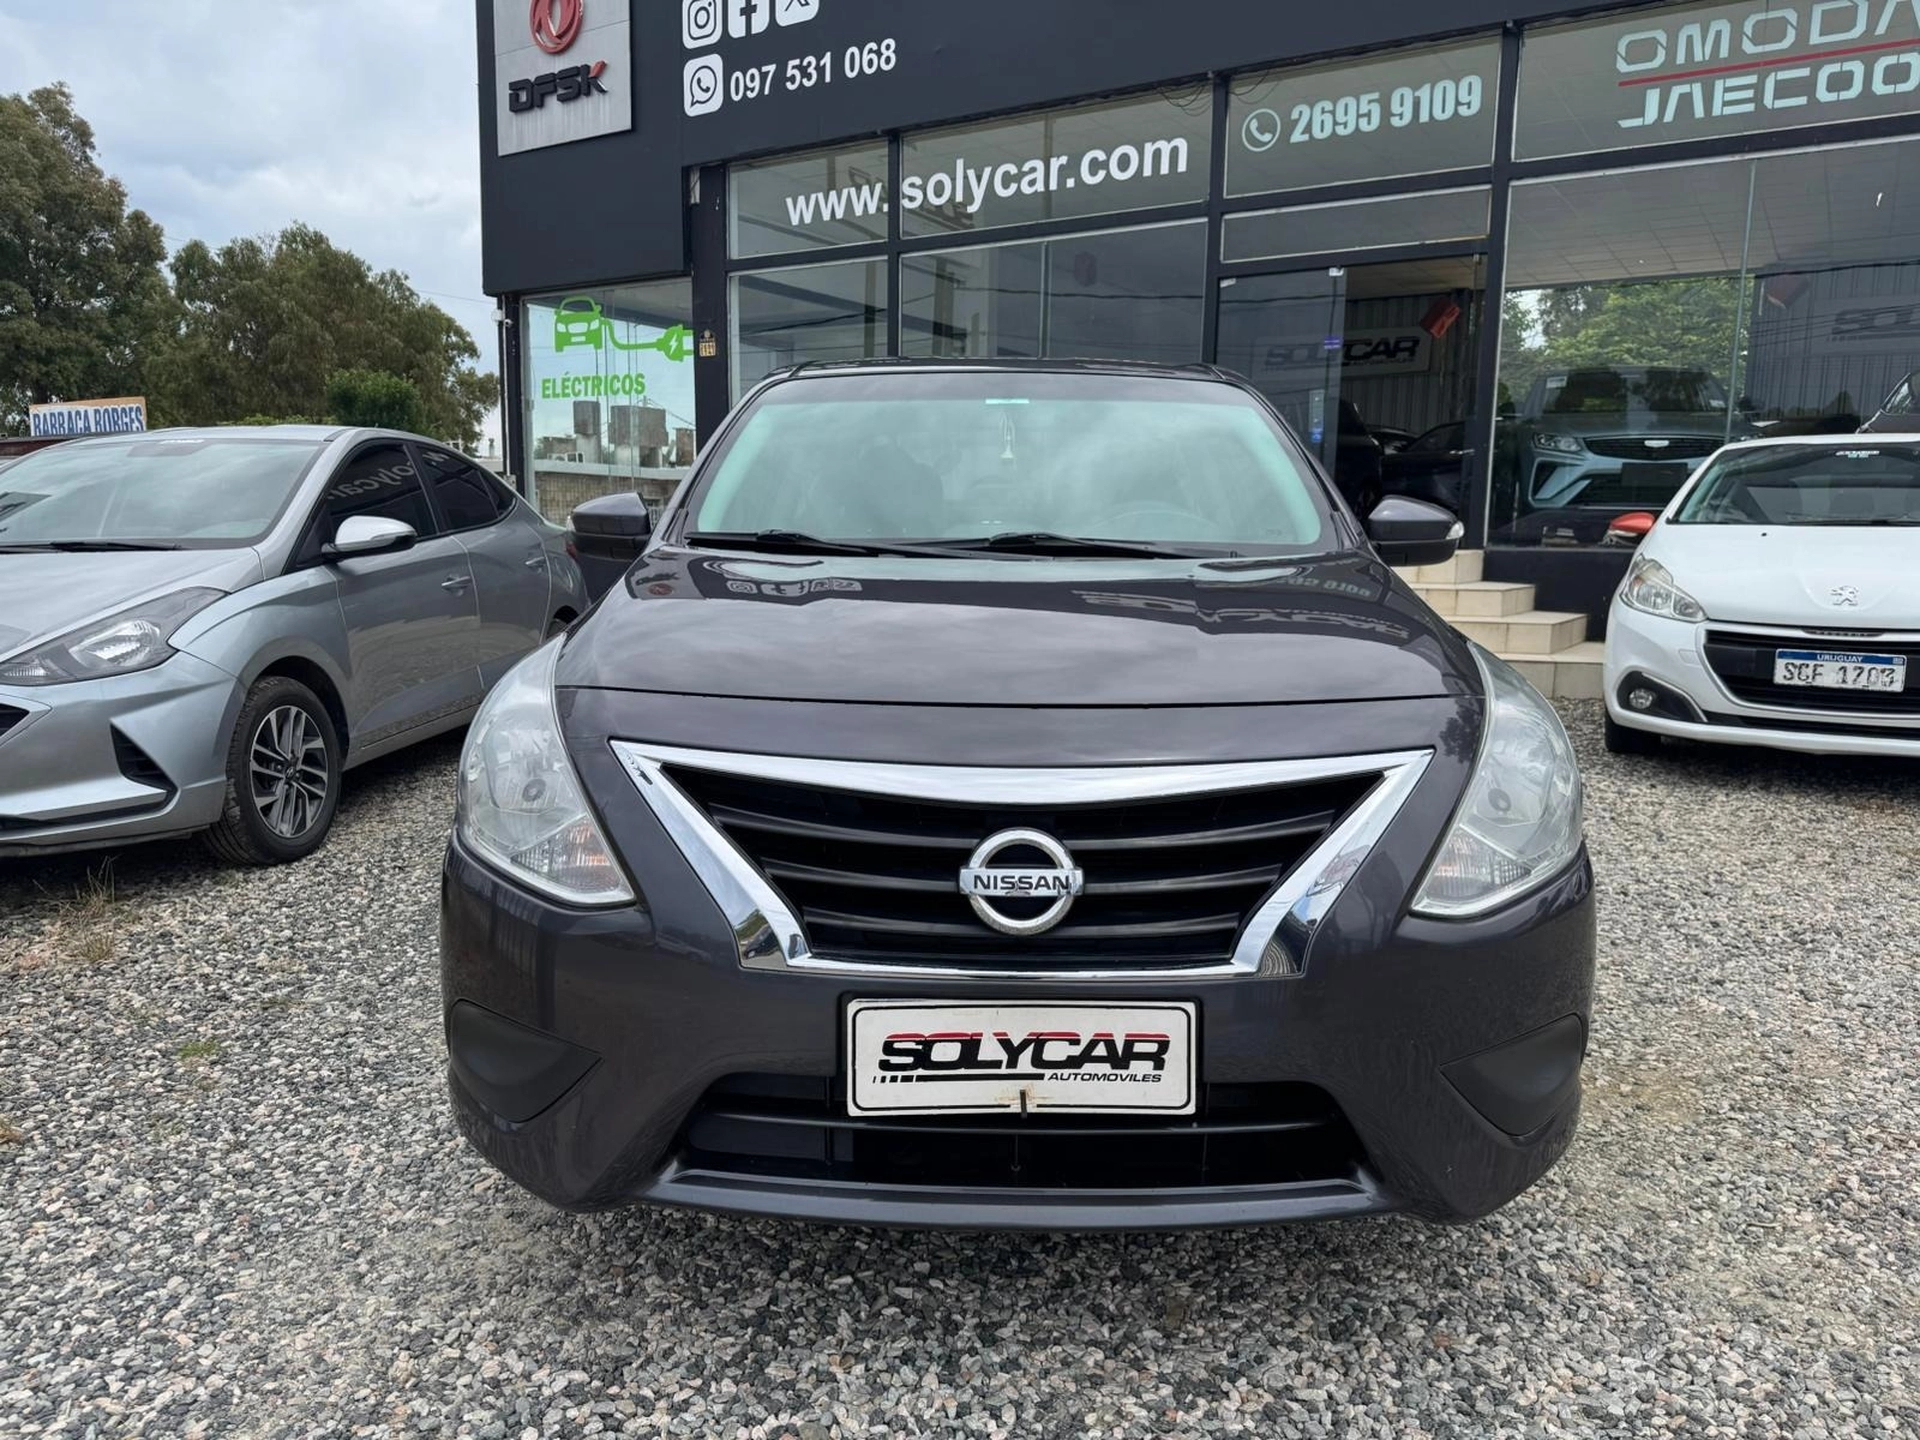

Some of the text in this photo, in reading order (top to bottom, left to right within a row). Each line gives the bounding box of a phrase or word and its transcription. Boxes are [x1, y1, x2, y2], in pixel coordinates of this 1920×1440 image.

[508, 60, 608, 113] DFSK
[730, 38, 897, 102] 097 531 068
[1617, 52, 1920, 128] JAECOO
[1290, 75, 1482, 143] 2695 9109
[541, 371, 646, 399] ELÉCTRICOS
[1816, 654, 1864, 663] URUGUAY
[973, 874, 1071, 891] NISSAN
[878, 1032, 1171, 1072] SOLYCAR
[1047, 1072, 1162, 1083] AUTOMOVILES
